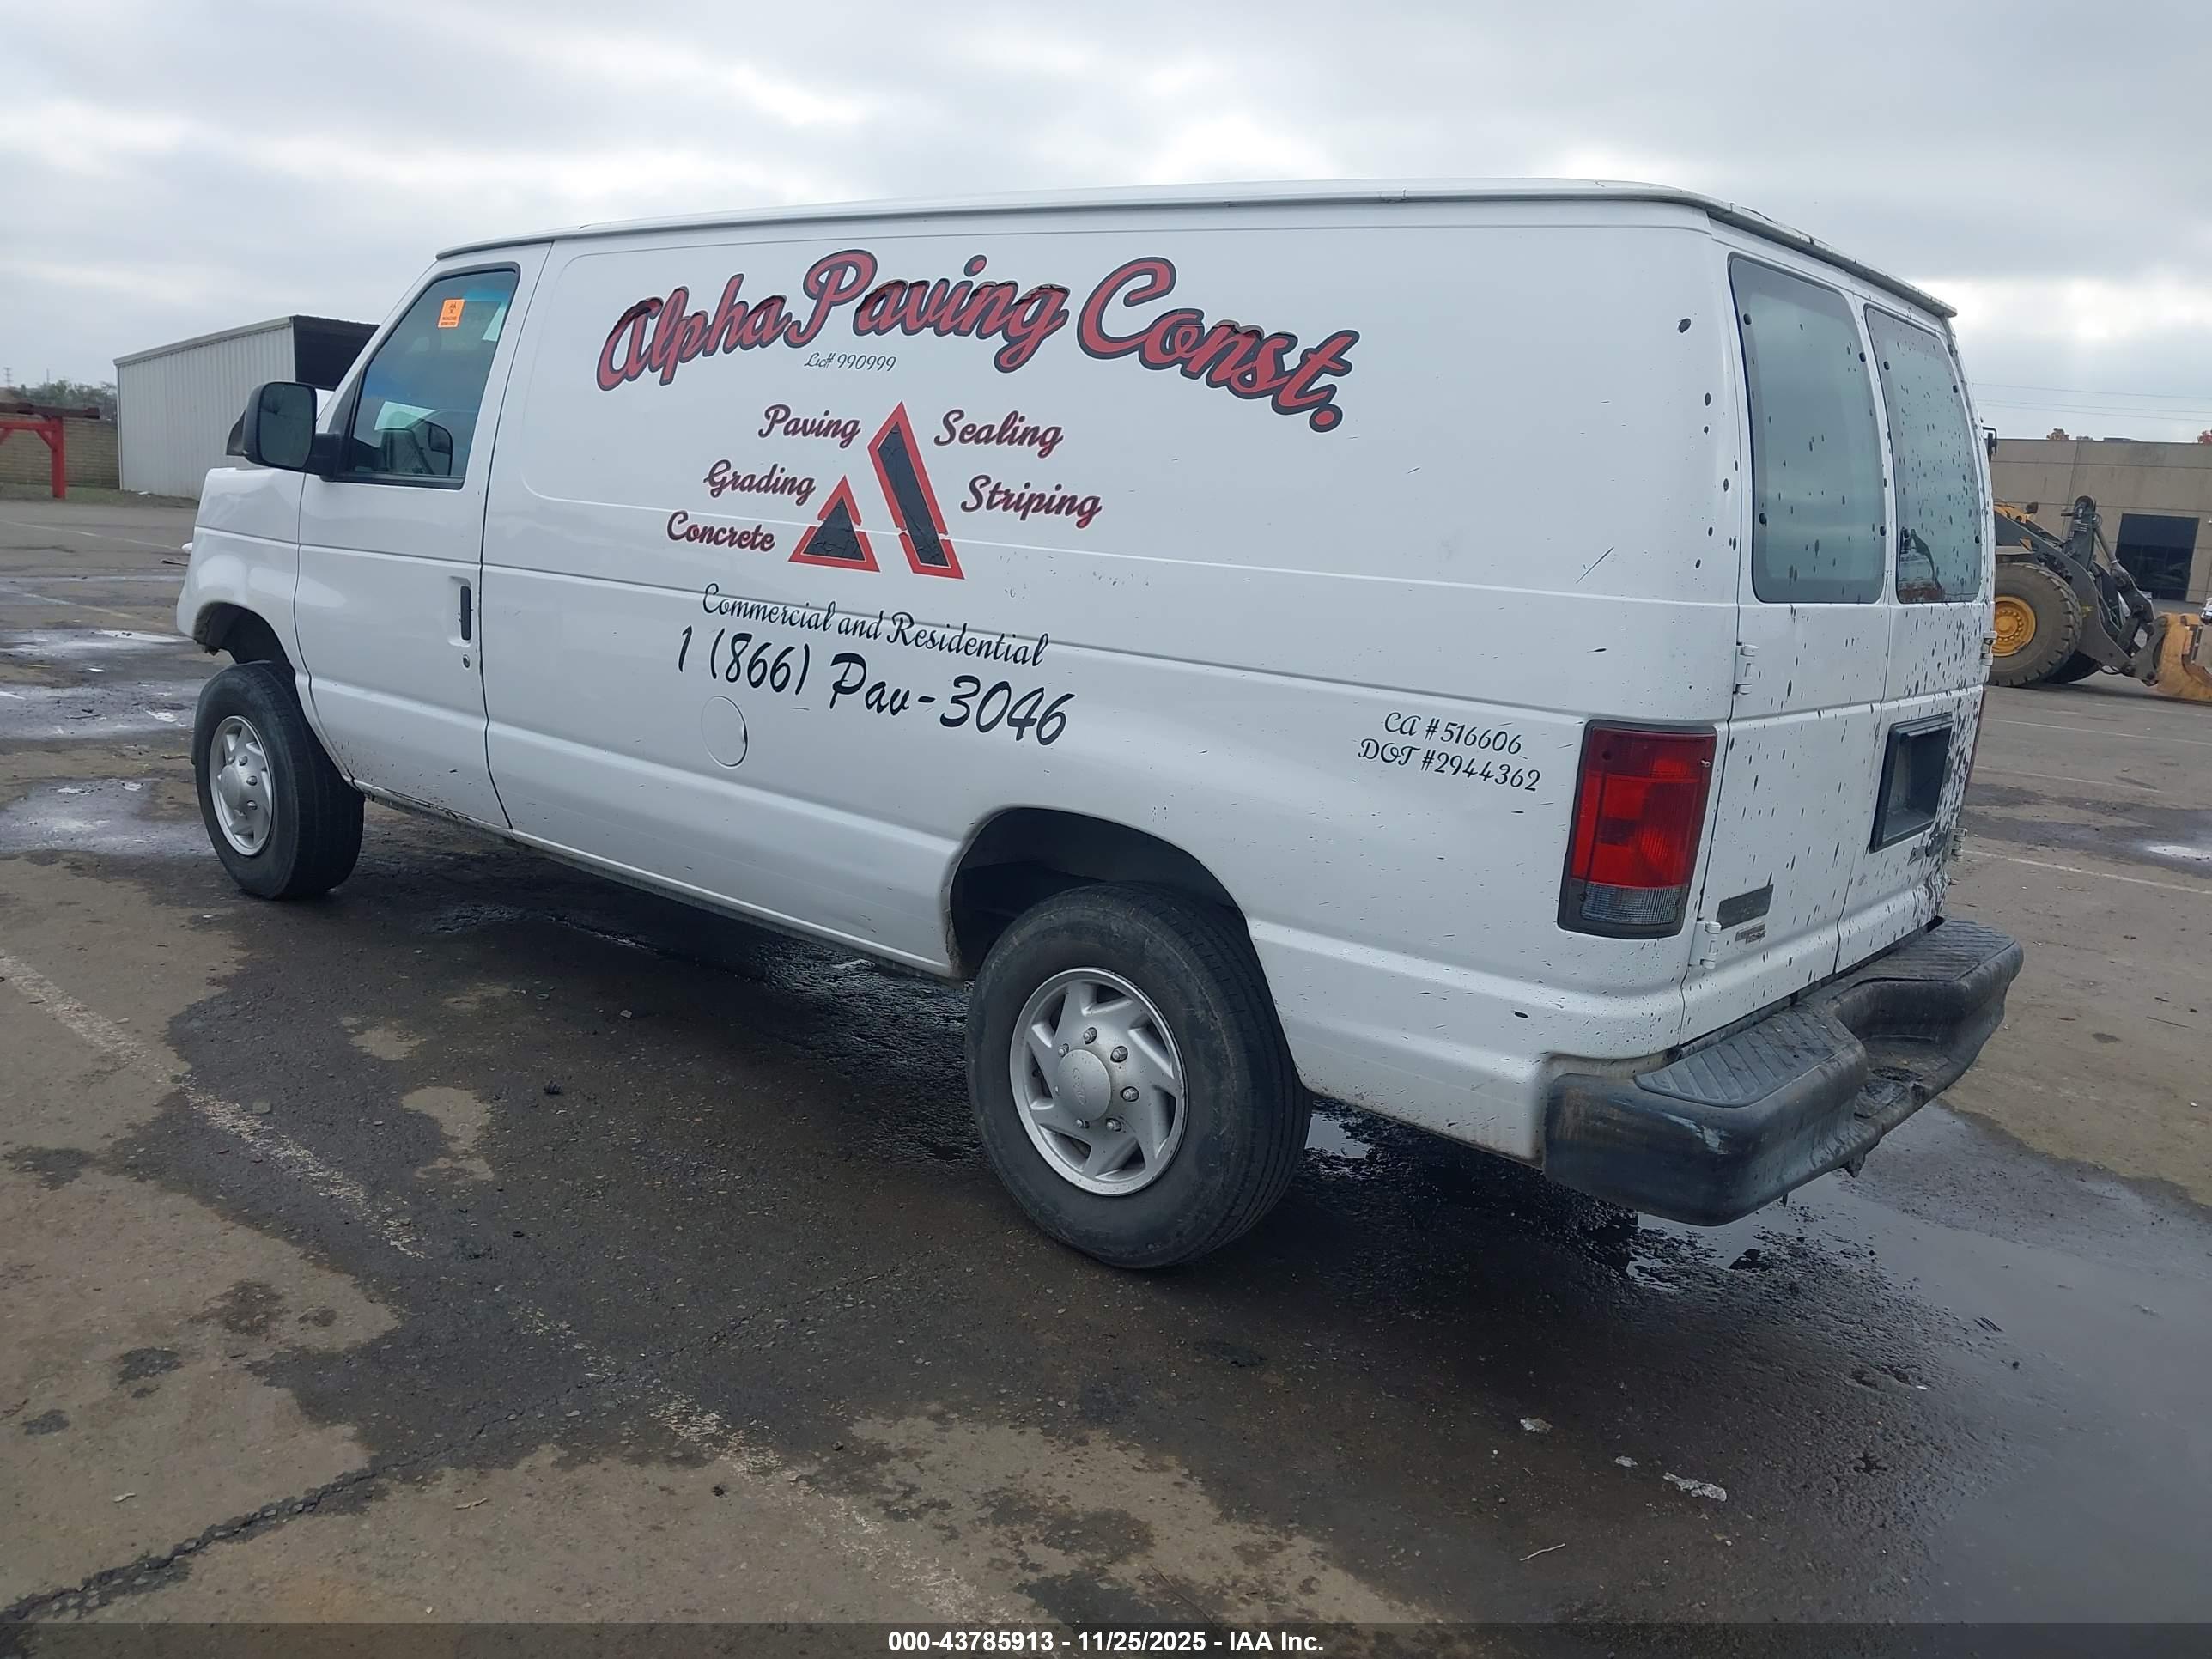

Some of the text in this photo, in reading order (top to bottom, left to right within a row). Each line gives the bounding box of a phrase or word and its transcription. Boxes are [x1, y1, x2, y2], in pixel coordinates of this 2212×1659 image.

[597, 249, 1361, 433] Alpha Paving Const.
[837, 353, 896, 372] 990999
[758, 404, 861, 448] Paving
[933, 410, 1063, 458] Sealing
[703, 459, 816, 506] Grading
[961, 475, 1103, 529] Striping
[665, 511, 776, 553] Concrete
[702, 582, 1049, 667] Commercial and Residential
[677, 624, 1076, 746] 1 (866) Pav-3046
[1384, 712, 1522, 755] CA #516606
[1358, 738, 1541, 792] DOT #2944362
